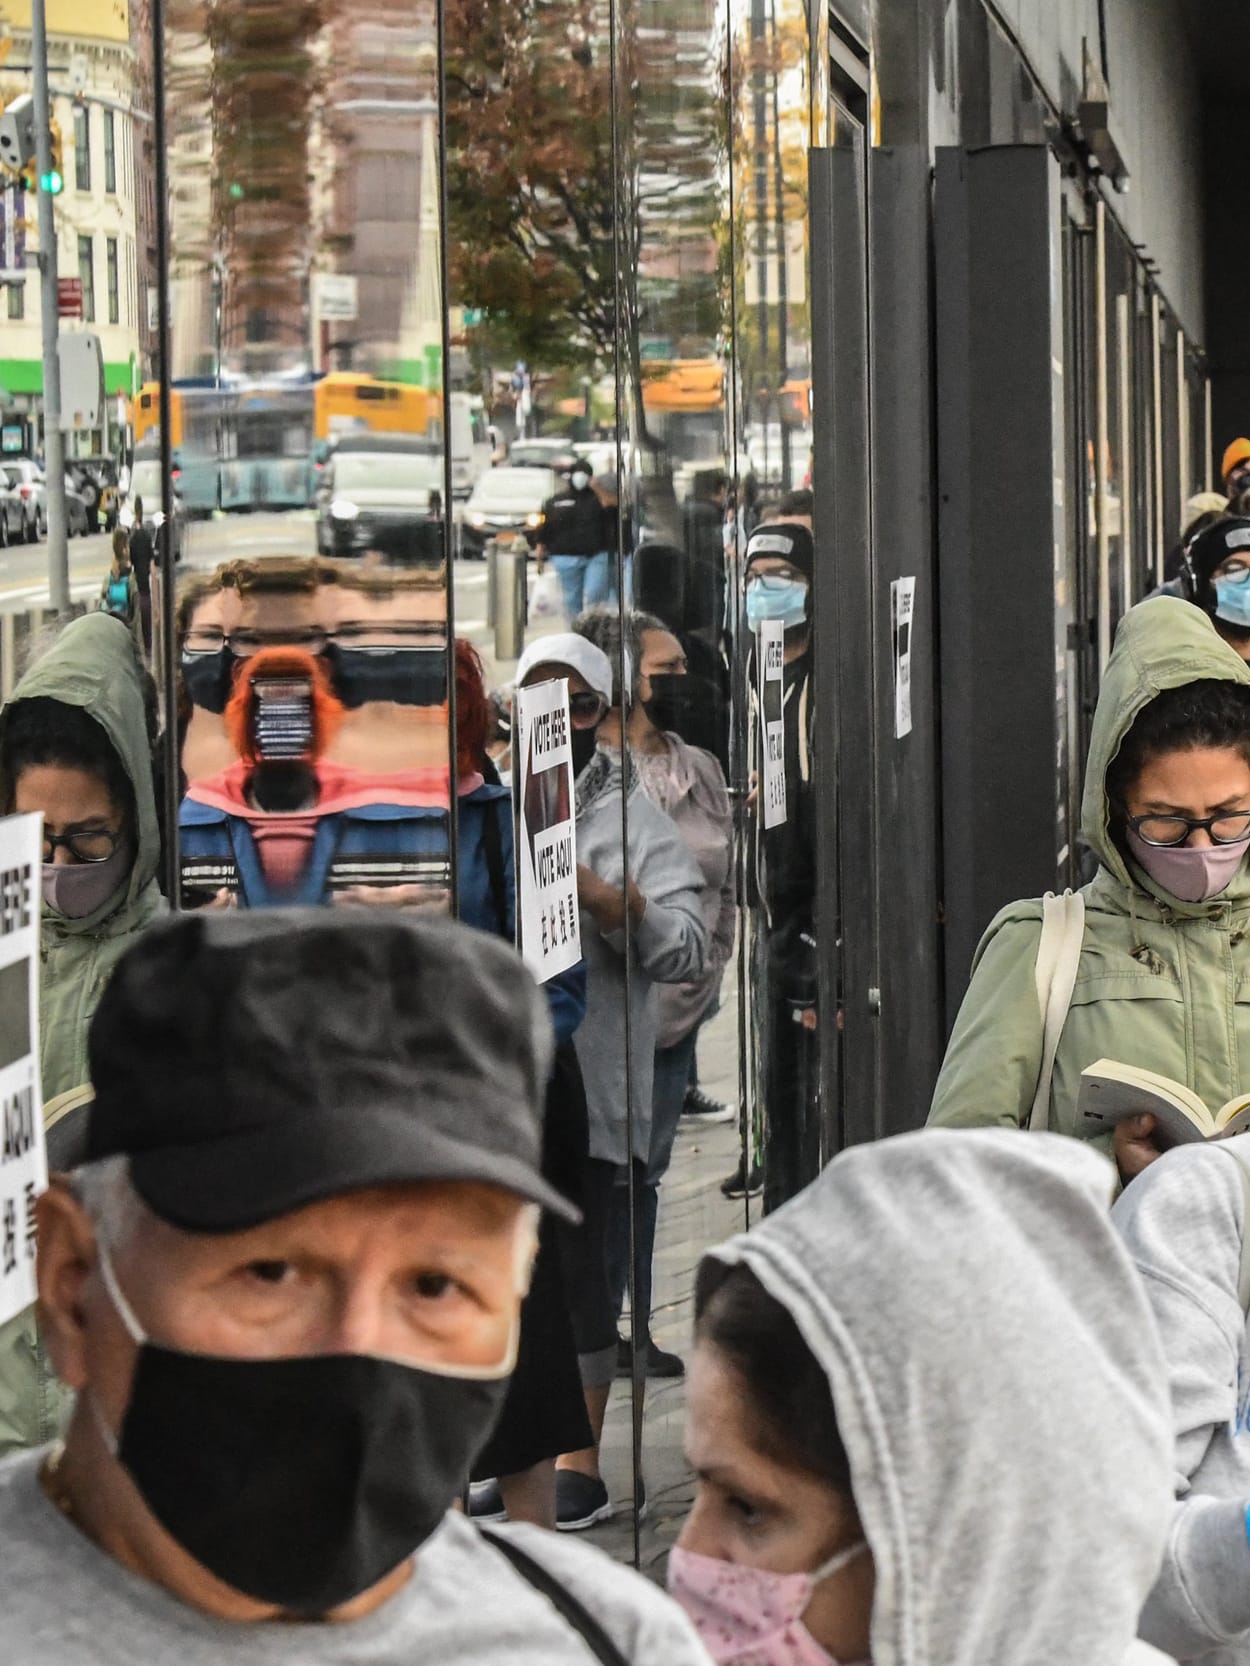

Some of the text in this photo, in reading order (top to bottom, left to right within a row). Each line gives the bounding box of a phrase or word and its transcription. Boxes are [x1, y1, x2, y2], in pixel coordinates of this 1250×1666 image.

[533, 713, 551, 756] VOTE
[551, 707, 567, 749] HERE
[537, 844, 555, 889] VOTE
[0, 863, 31, 935] ERE
